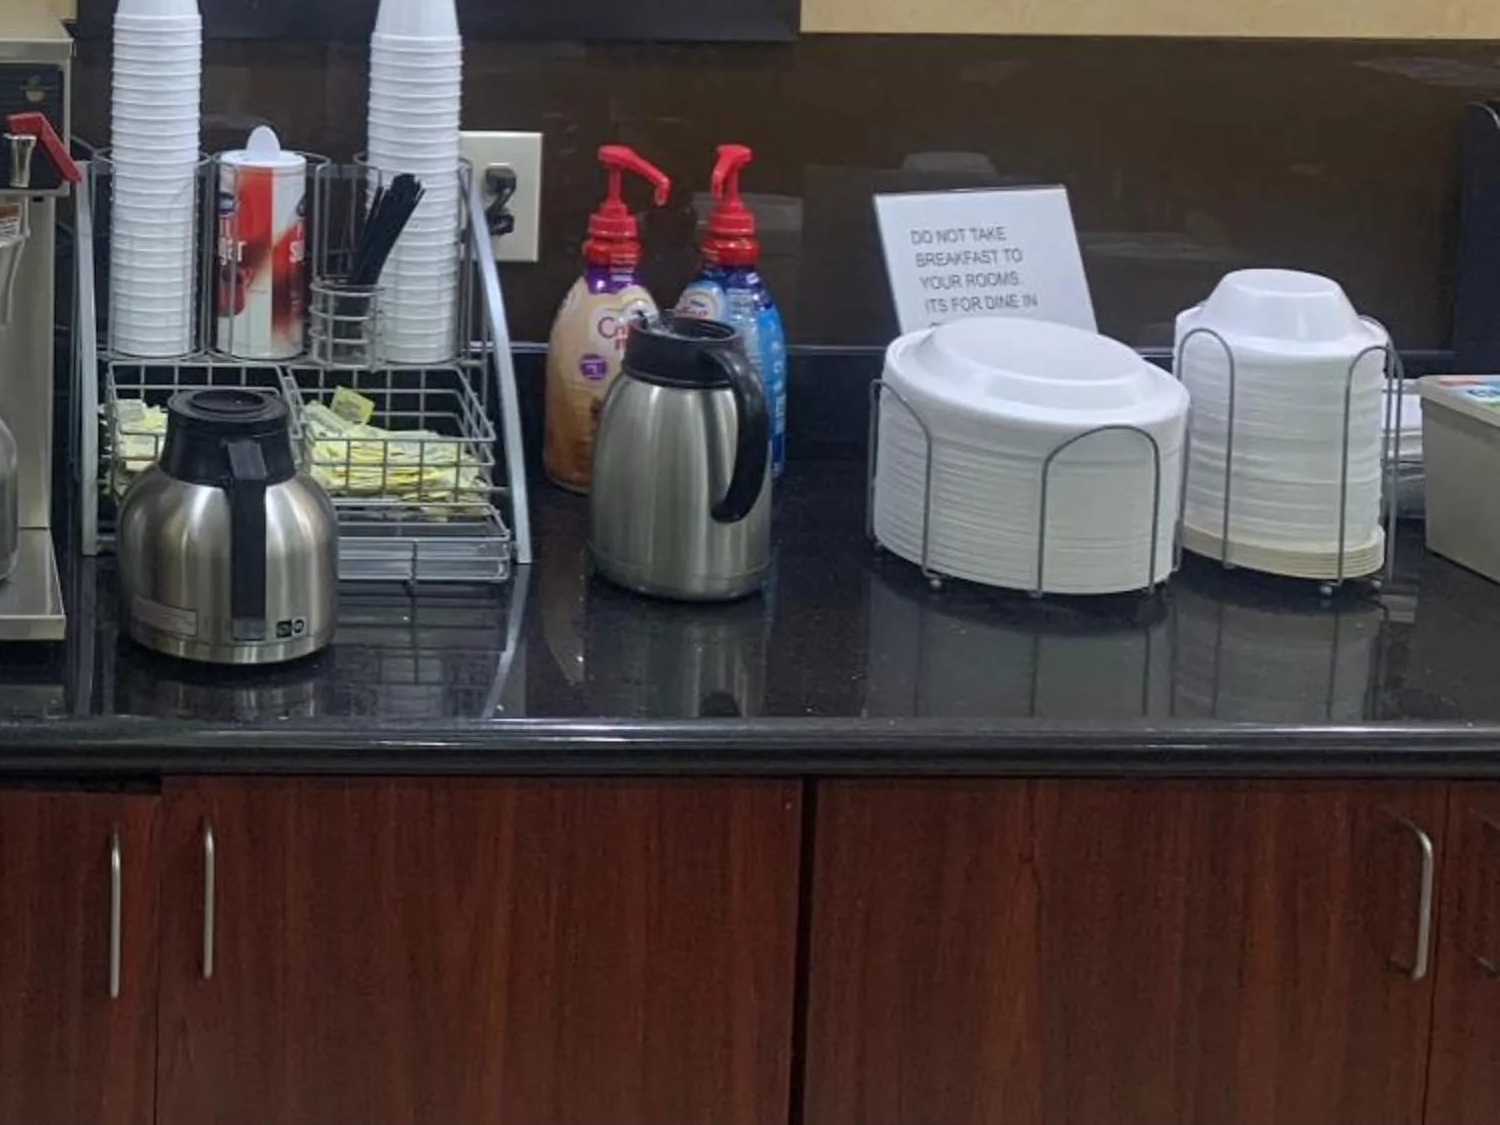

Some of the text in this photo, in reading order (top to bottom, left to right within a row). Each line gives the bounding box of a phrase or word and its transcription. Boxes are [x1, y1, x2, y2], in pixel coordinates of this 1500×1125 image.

[910, 226, 1008, 245] DO NOT TAKE
[916, 248, 1024, 268] BREAKFAST TO
[918, 273, 961, 290] YOUR
[925, 293, 1039, 314] ITS FOR DINE IN
